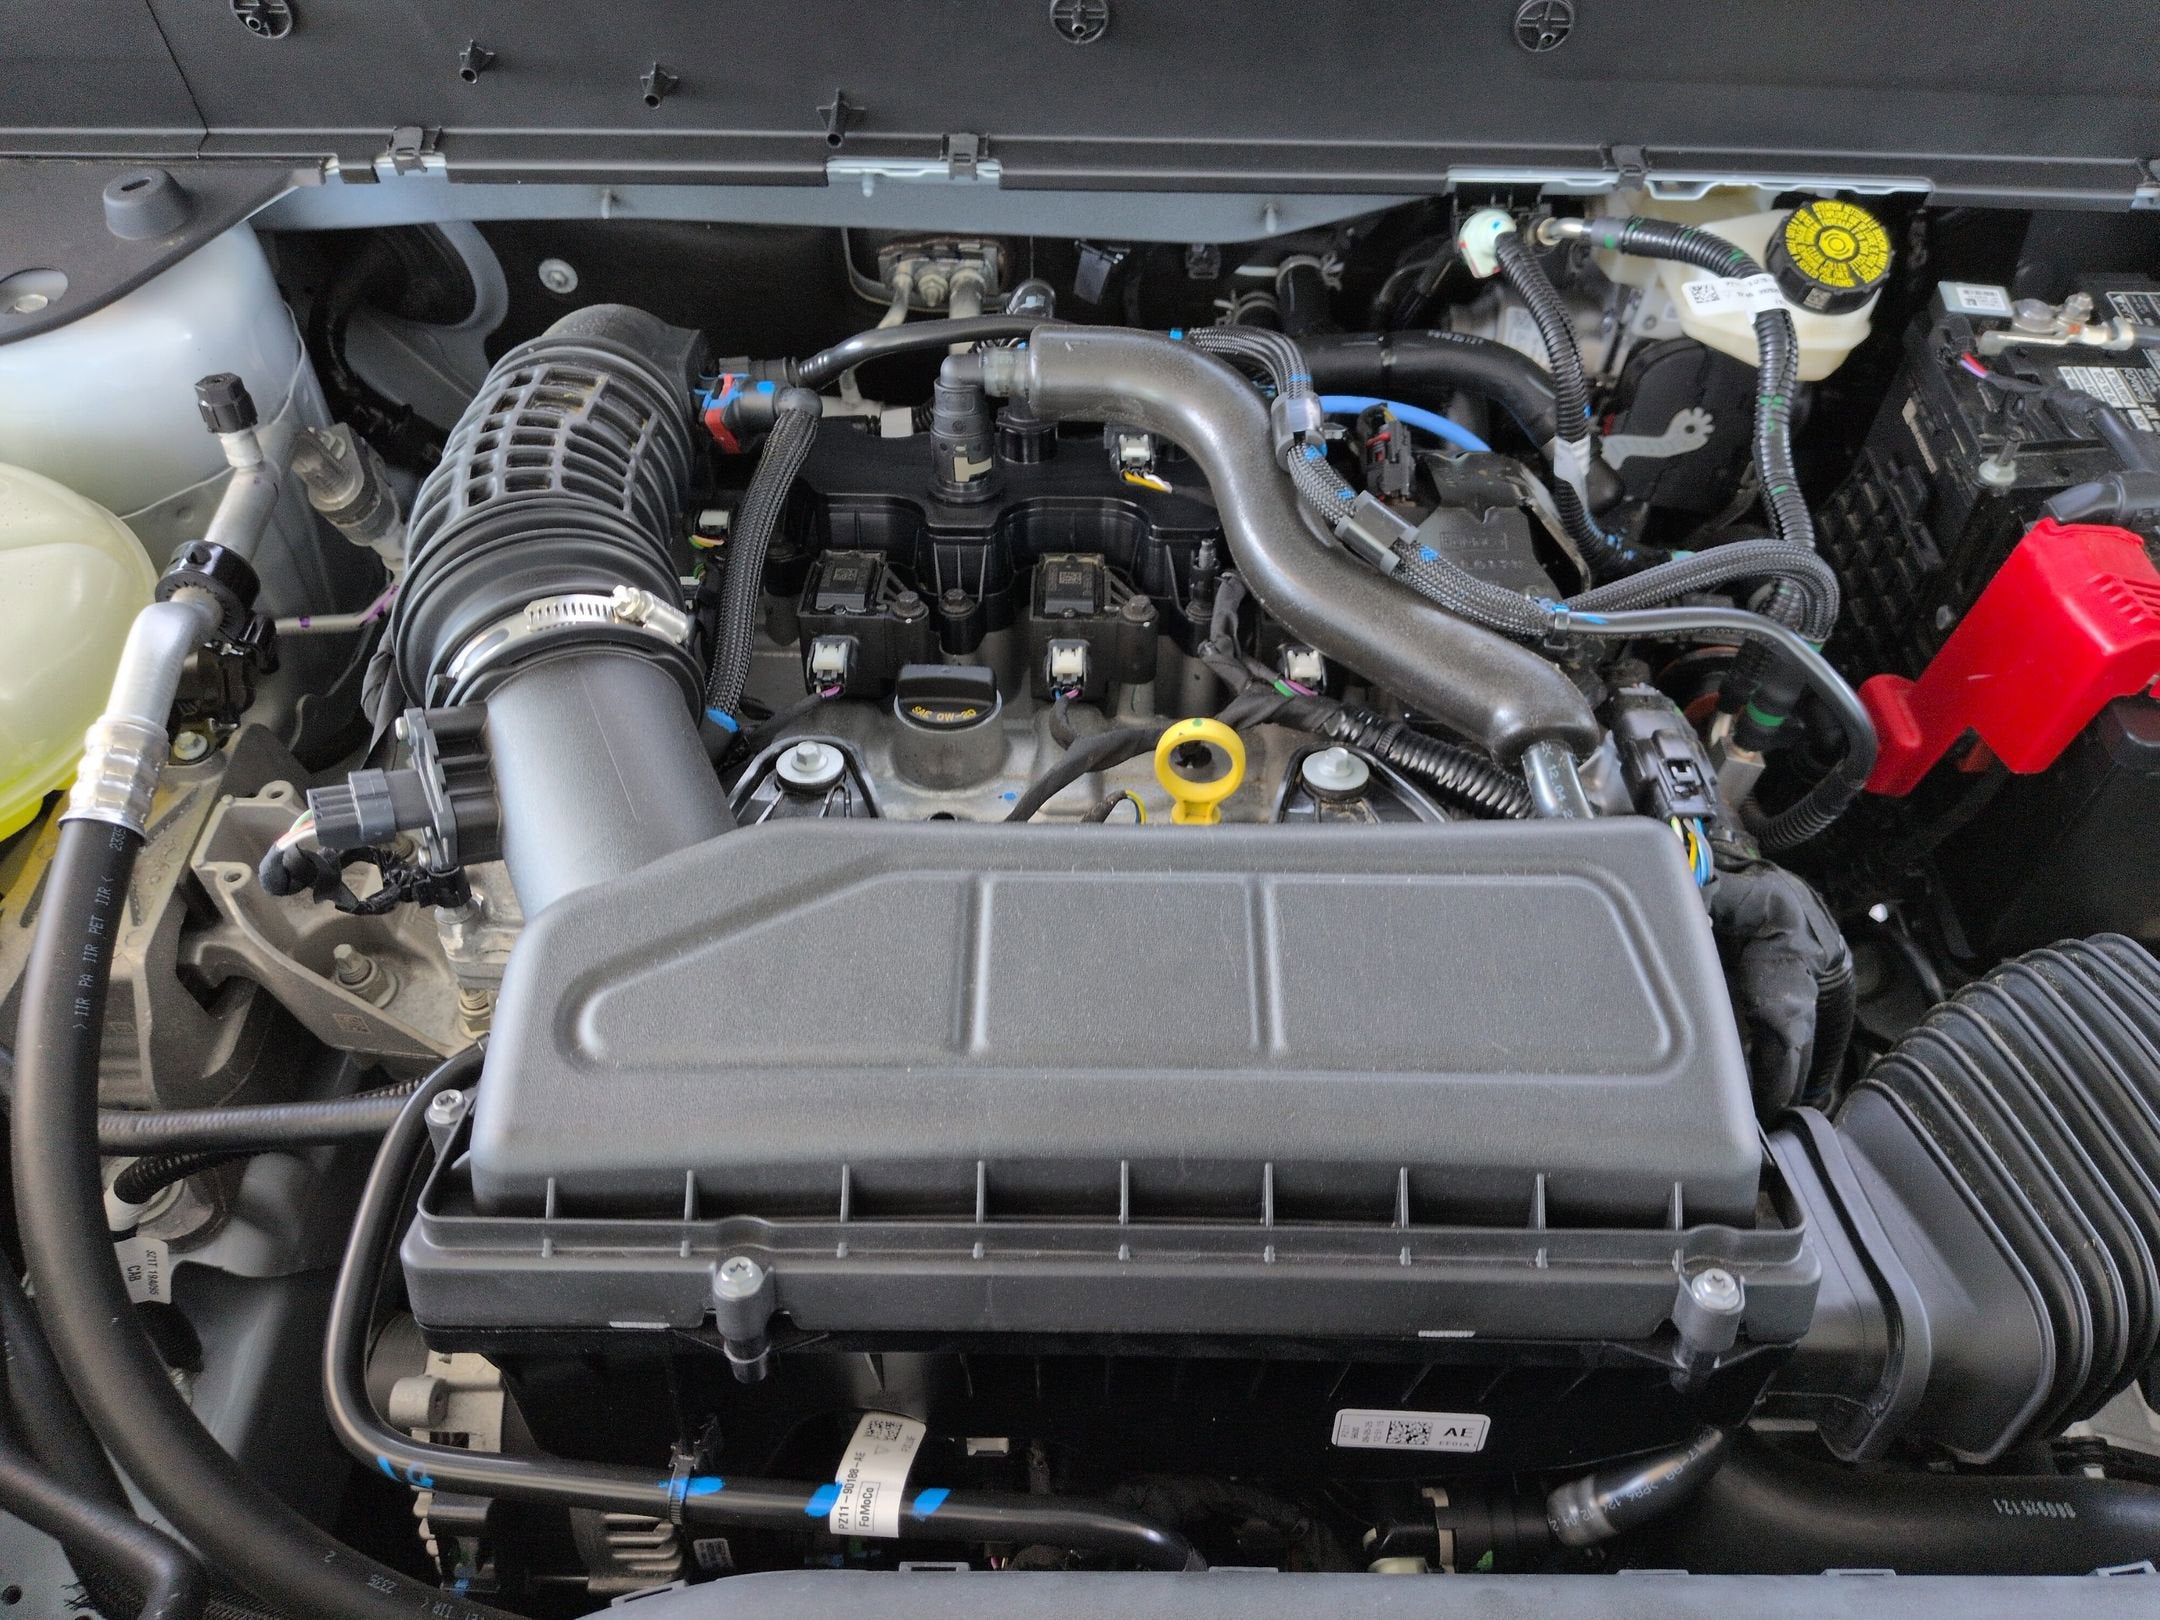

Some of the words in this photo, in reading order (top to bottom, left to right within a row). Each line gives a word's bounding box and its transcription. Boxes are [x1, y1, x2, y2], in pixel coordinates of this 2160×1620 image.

[912, 705, 933, 719] SAE
[88, 914, 105, 936] PET
[127, 1265, 141, 1282] CAB
[1444, 1427, 1475, 1438] AE
[858, 1487, 875, 1529] FoMoCo
